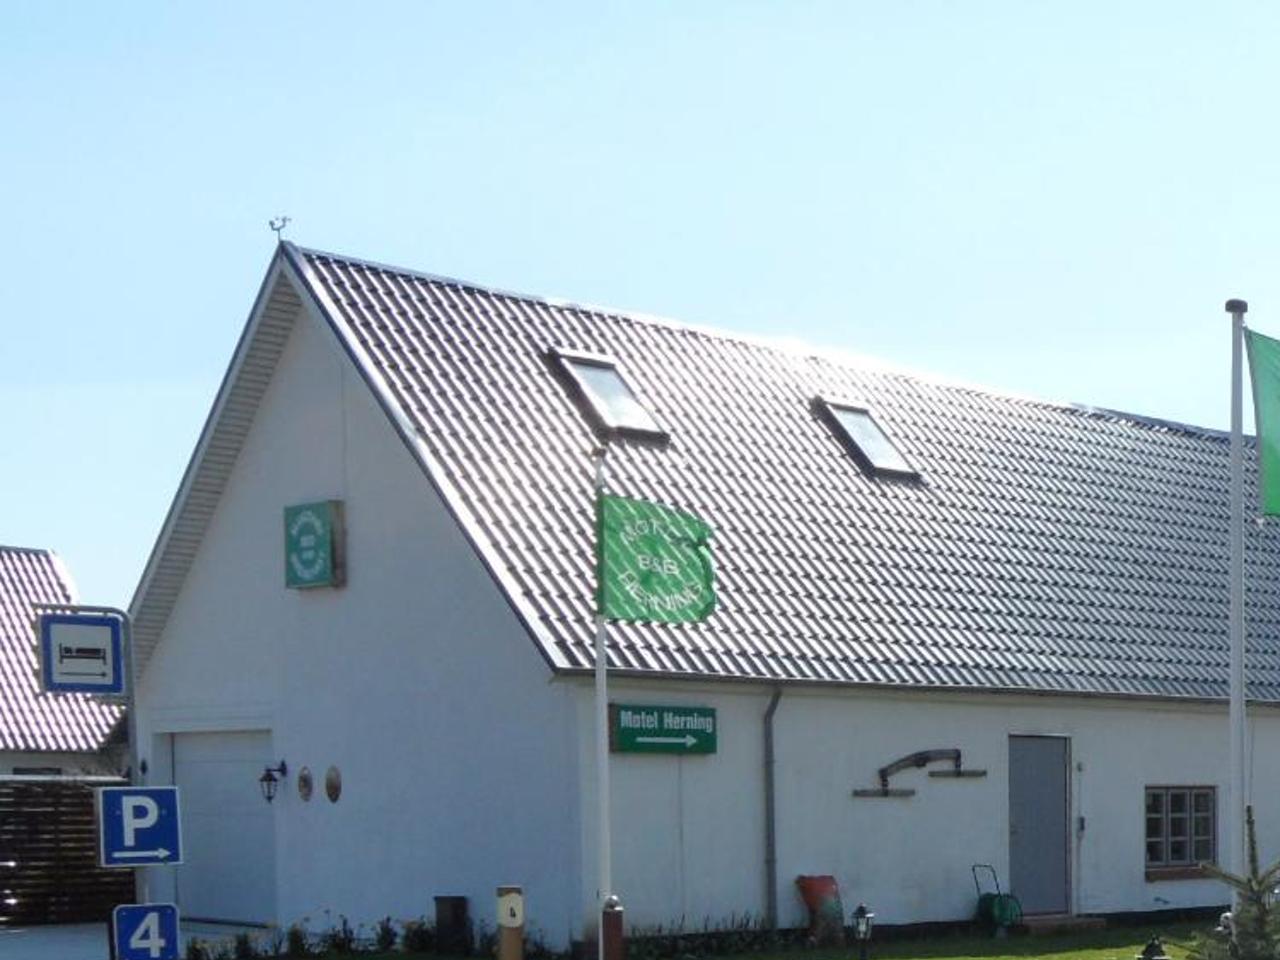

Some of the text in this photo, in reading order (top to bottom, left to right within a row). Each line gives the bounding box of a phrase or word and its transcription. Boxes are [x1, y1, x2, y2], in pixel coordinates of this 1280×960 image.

[621, 518, 691, 553] MOT
[638, 555, 679, 575] B&B
[621, 710, 713, 733] Motel Herning
[122, 795, 158, 847] P
[129, 911, 165, 958] 4
